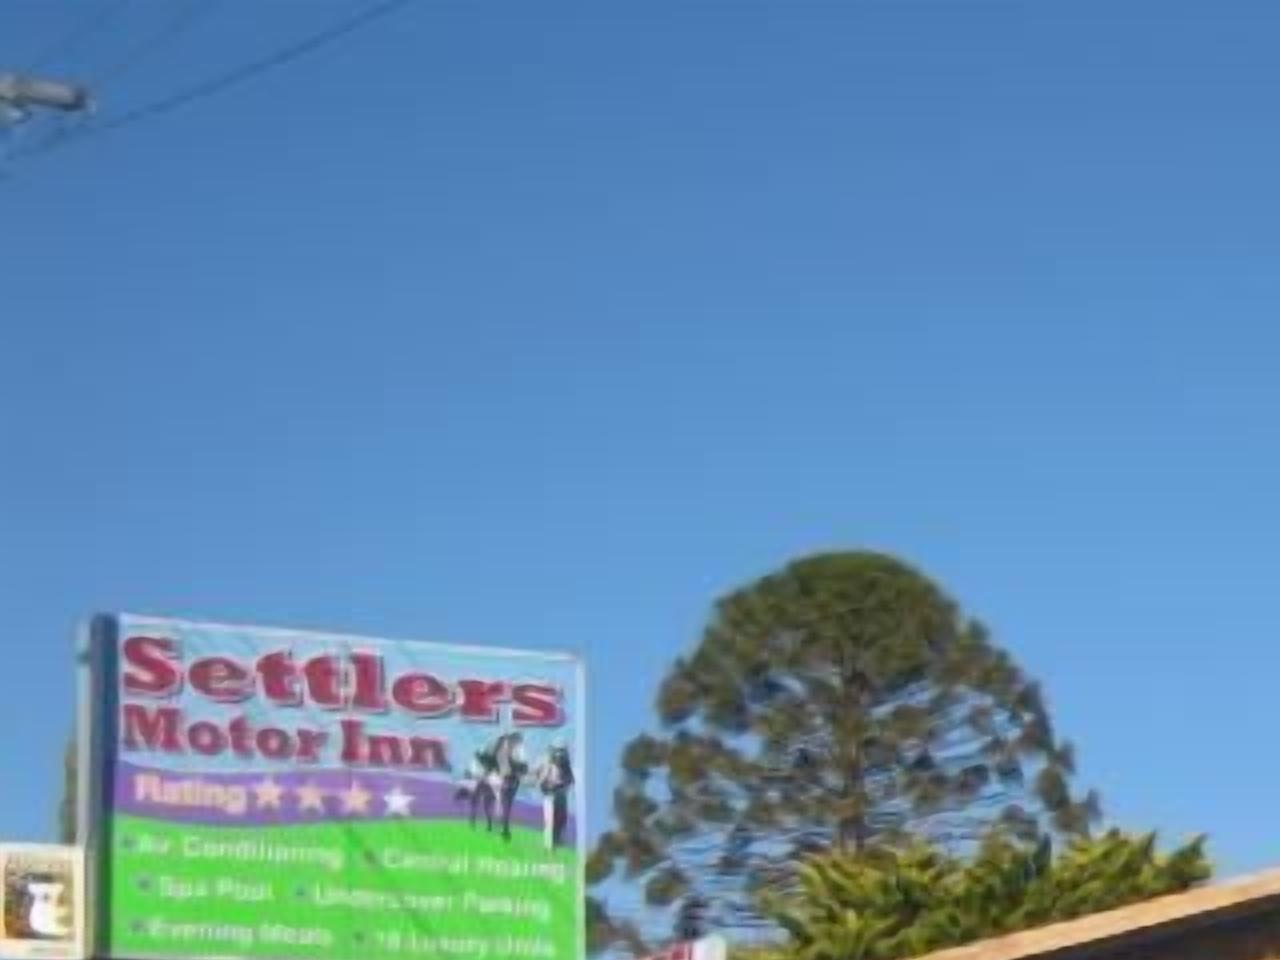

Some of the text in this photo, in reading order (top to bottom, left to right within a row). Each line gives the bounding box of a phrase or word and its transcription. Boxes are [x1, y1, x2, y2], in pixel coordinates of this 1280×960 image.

[122, 636, 565, 727] Settlers
[122, 704, 450, 771] Motor Inn
